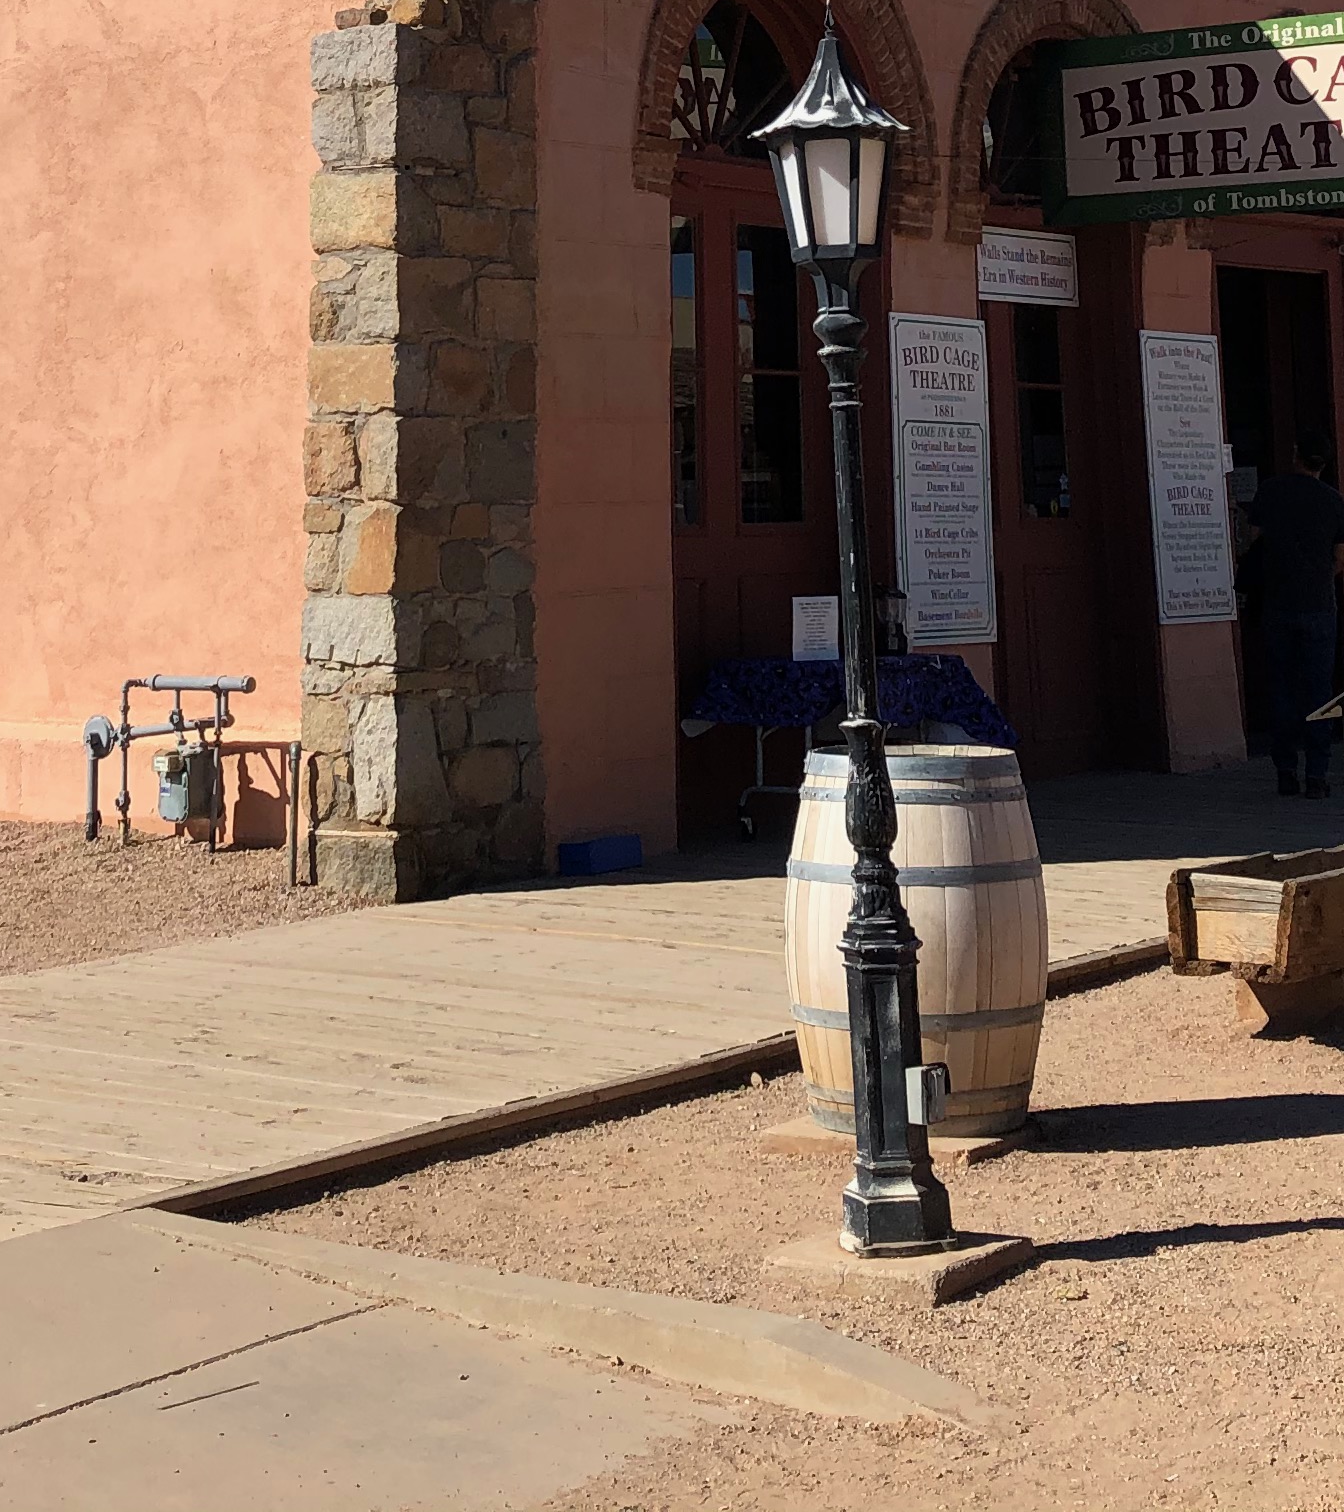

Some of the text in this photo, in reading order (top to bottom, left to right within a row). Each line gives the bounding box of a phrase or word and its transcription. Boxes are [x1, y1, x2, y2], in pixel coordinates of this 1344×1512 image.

[1188, 17, 1344, 50] The Original
[1073, 61, 1260, 139] BIRD
[1193, 193, 1217, 214] of
[980, 243, 1072, 266] Walls Stand the Remains
[983, 267, 997, 283] Era
[999, 268, 1006, 283] in
[1007, 268, 1039, 286] Western
[1041, 271, 1068, 291] History
[932, 331, 964, 342] FAMOUS
[901, 345, 980, 371] BIRD CAGE
[910, 370, 976, 392] THEATRE
[934, 404, 954, 417] 1881
[911, 426, 936, 437] COME
[937, 427, 948, 438] IN
[949, 427, 955, 438] &
[911, 440, 941, 452] Original
[943, 441, 956, 452] Bar
[1166, 485, 1214, 502] BIRD CAGE
[1171, 503, 1212, 516] THEATRE
[928, 568, 950, 579] Poker
